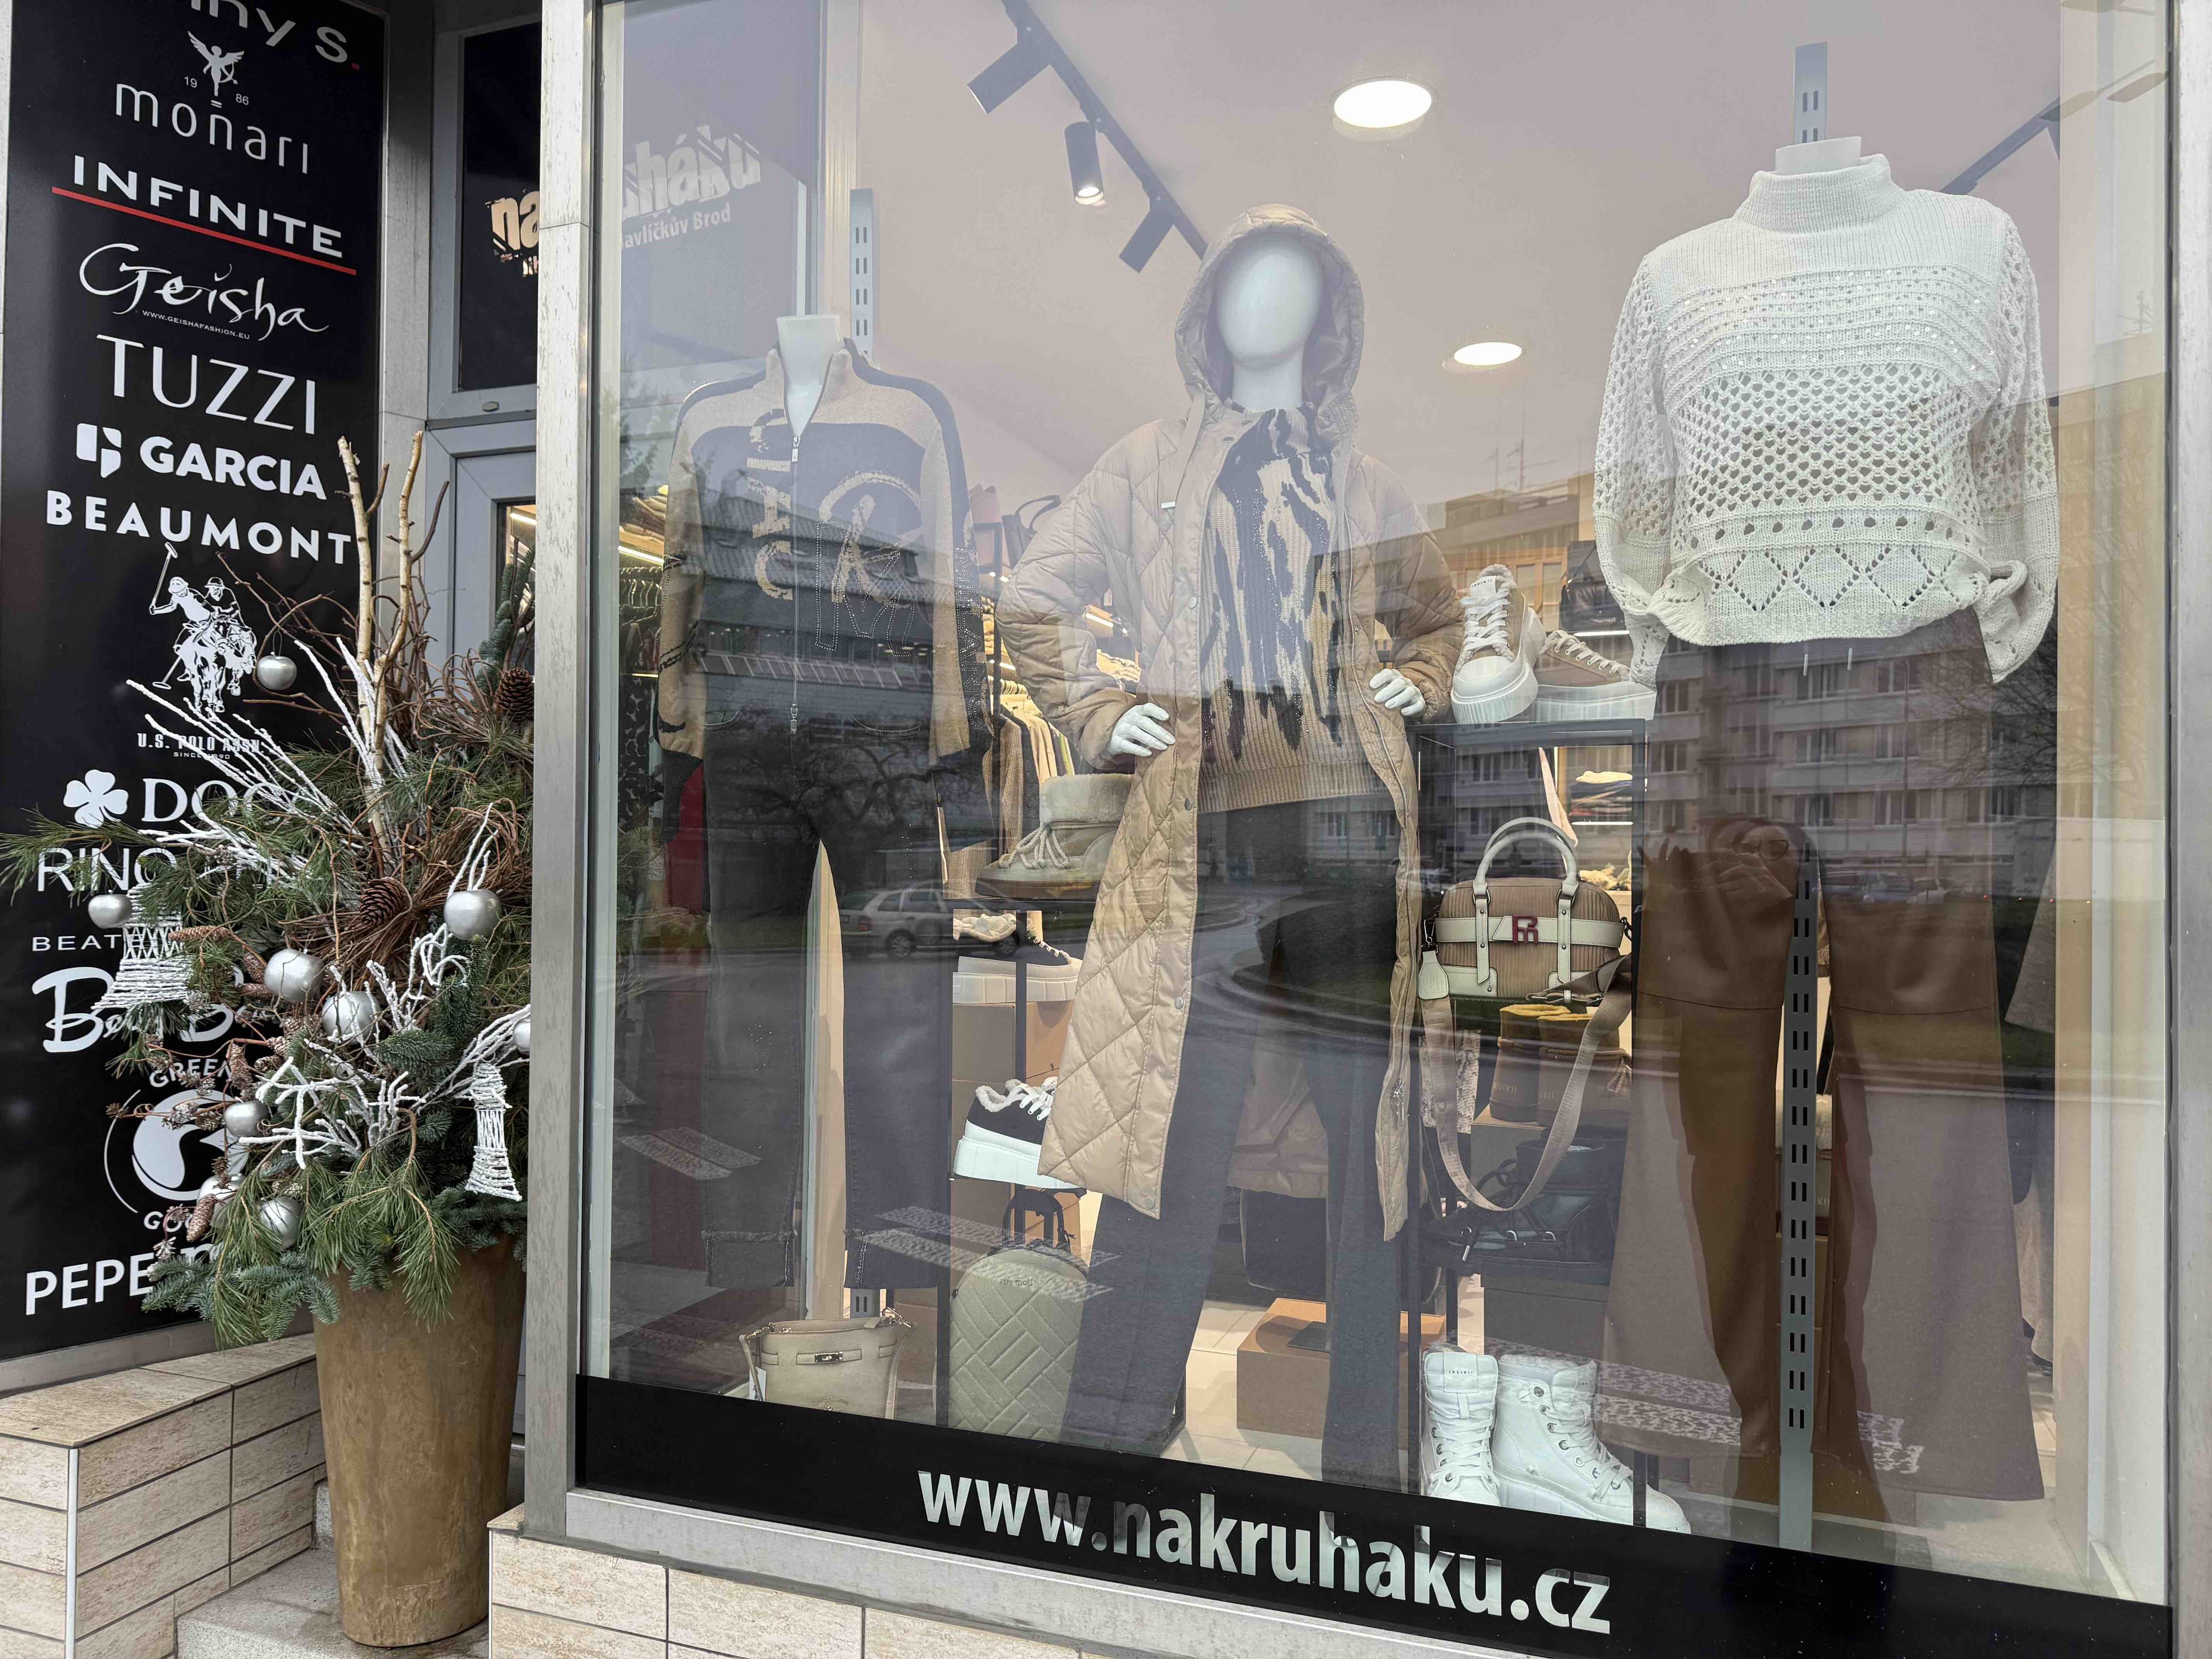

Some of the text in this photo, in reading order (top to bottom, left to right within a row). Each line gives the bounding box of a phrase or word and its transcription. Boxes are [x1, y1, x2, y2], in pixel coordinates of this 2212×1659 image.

[184, 76, 249, 105] 19 86
[116, 83, 308, 174] monari
[74, 155, 342, 258] INFINITE
[693, 202, 731, 231] Brod
[79, 243, 328, 341] Geisha
[142, 310, 249, 340] WWW.GEISHAFASHION.EU
[97, 335, 315, 435] TUZZI
[140, 436, 327, 500] GARCIA
[47, 490, 351, 564] BEAUMONT
[137, 733, 170, 748] U.S.
[26, 1252, 155, 1316] PEPE
[916, 1470, 1610, 1635] www.nakruhaku.cz
